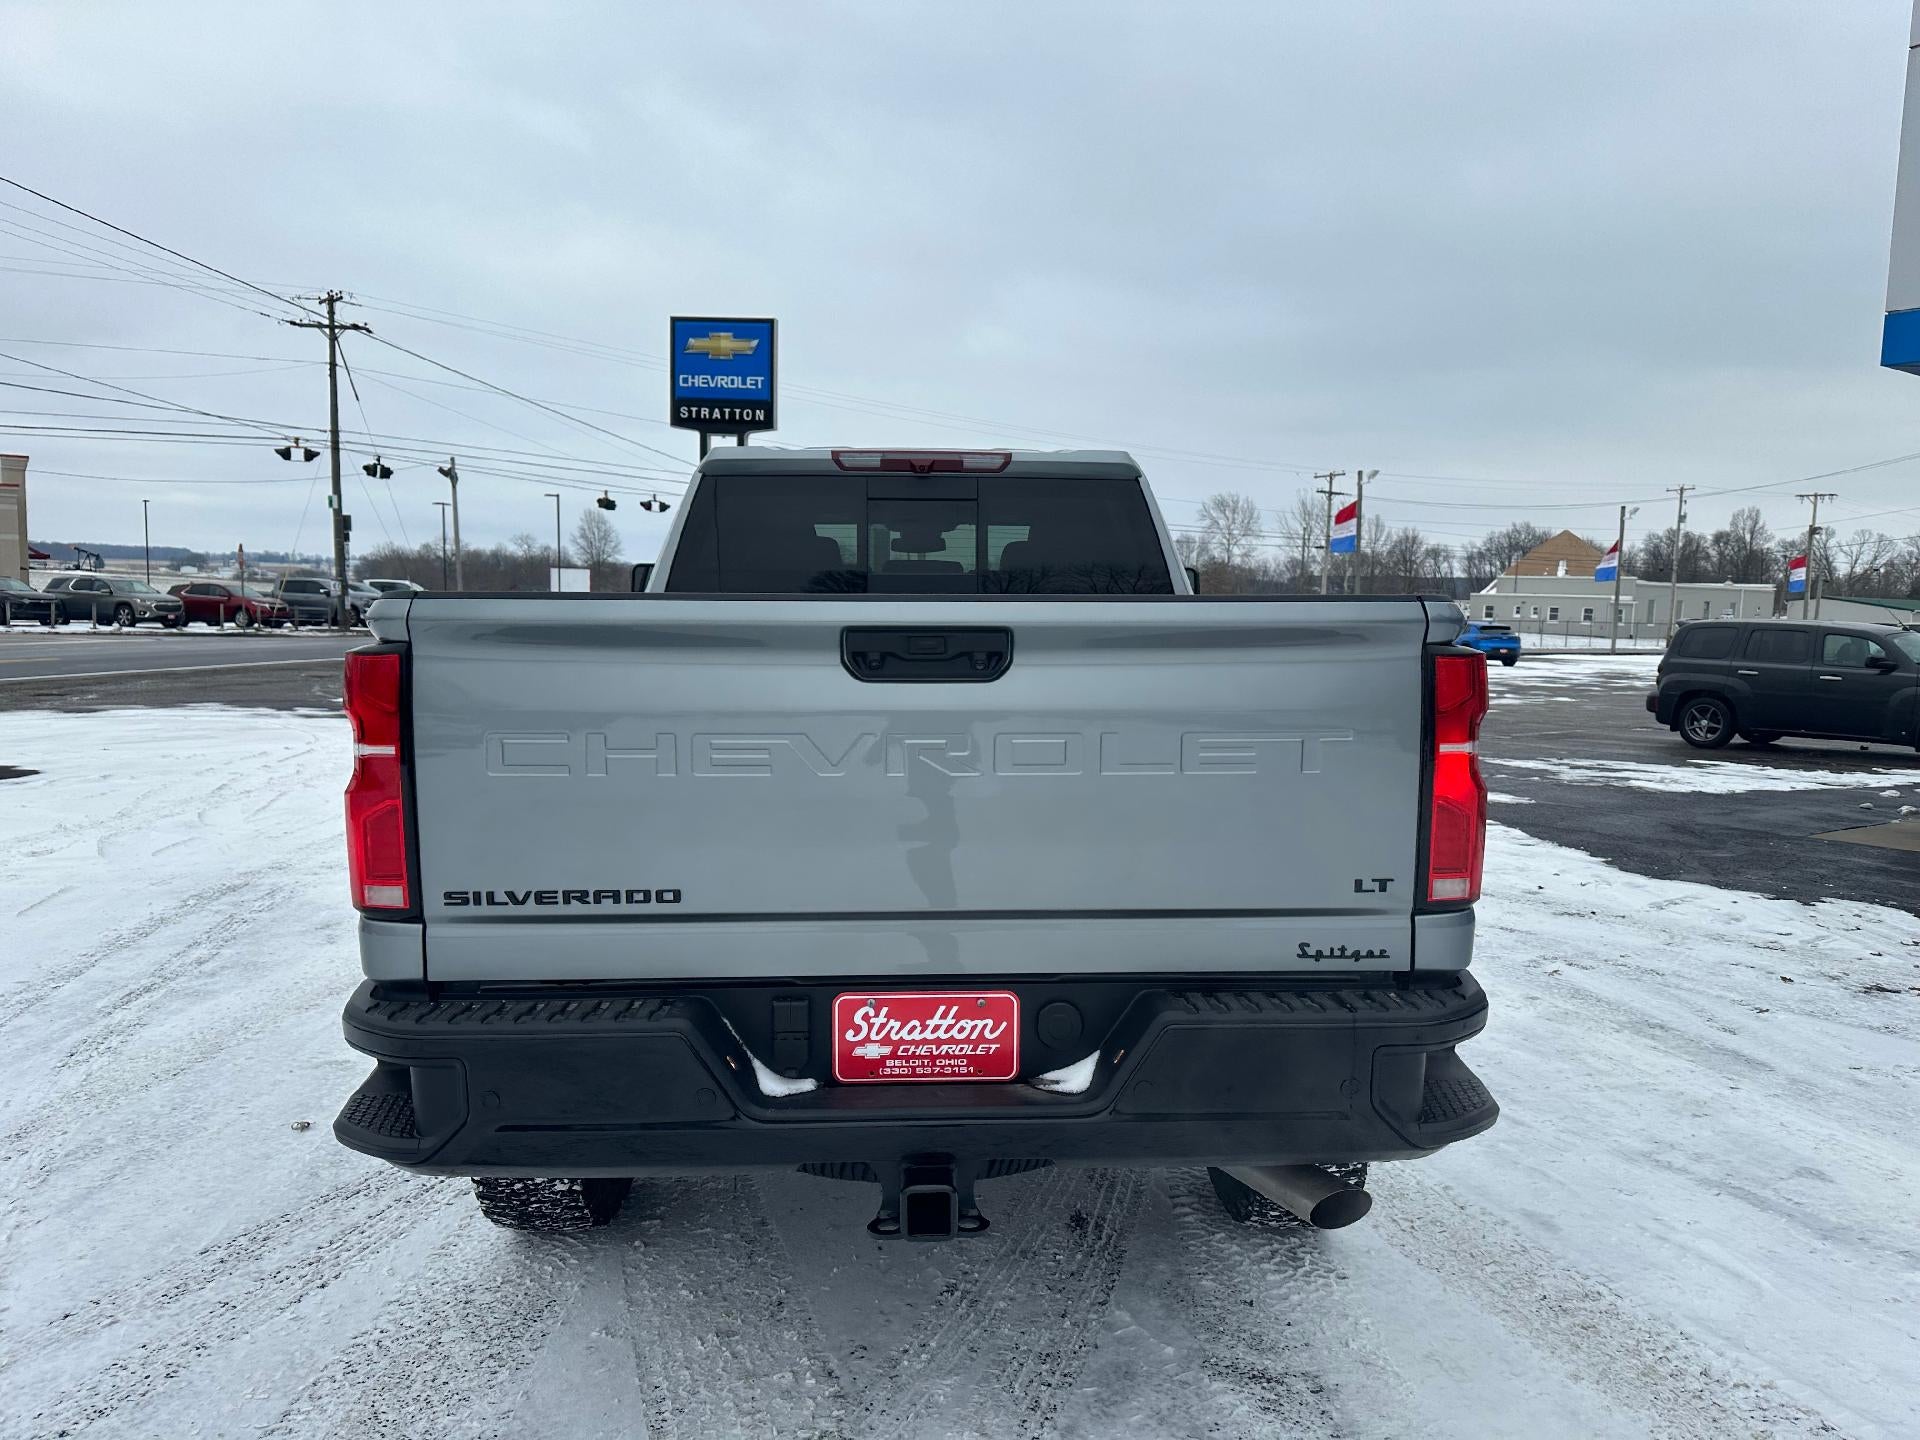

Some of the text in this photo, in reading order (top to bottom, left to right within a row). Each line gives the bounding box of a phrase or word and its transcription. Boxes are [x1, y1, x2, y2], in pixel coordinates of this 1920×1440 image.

[679, 374, 765, 389] CHEVROLET
[679, 406, 765, 421] STRATTON
[485, 730, 1354, 778] CHEVROLET
[1353, 878, 1395, 893] LT
[443, 888, 682, 906] SILVERADO
[845, 1005, 1008, 1042] Stratton
[897, 1043, 1001, 1056] CHEVROLET
[885, 1058, 967, 1067] BELOIT, OHIO
[879, 1066, 974, 1075] (330) 537-3151
